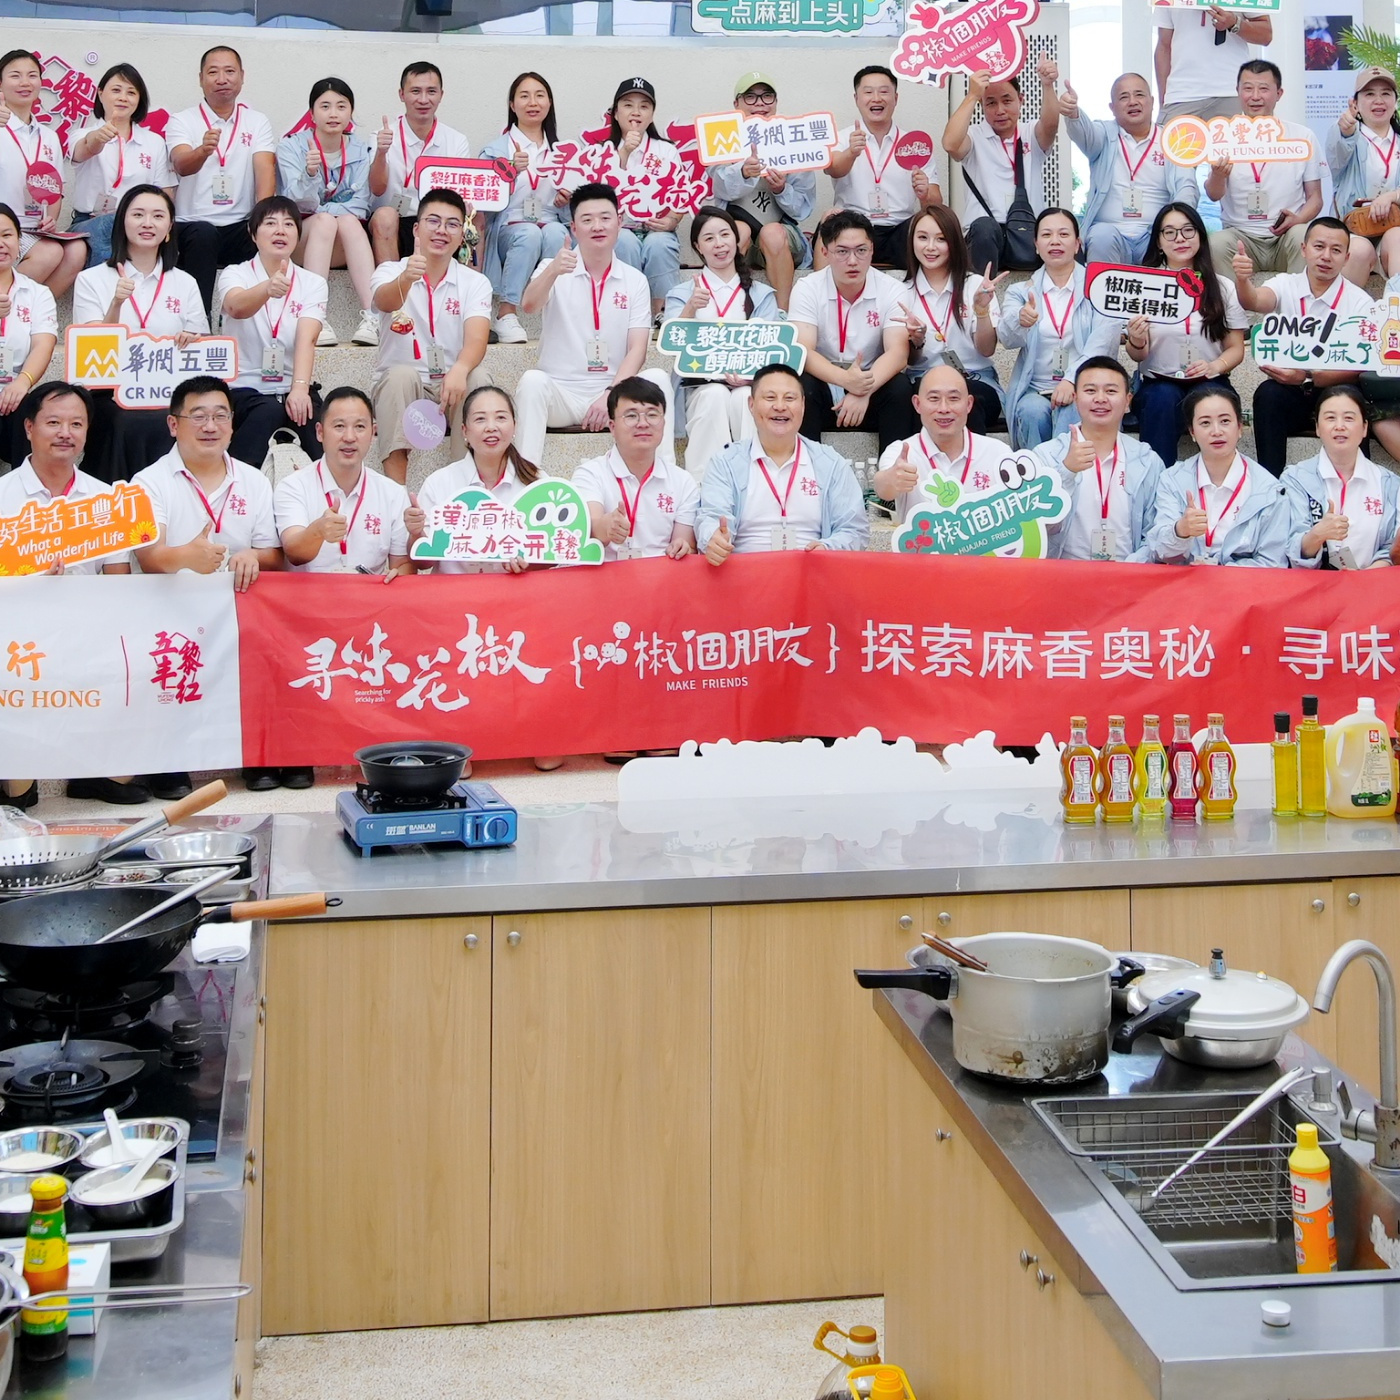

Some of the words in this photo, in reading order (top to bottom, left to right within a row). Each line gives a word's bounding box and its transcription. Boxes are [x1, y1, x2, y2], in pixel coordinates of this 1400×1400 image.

[951, 50, 968, 63] MAKE
[967, 36, 992, 52] FRIENDS
[1212, 123, 1275, 144] 五豐行
[768, 155, 787, 166] NG
[790, 151, 824, 165] FUNG
[1212, 147, 1230, 156] NG
[1233, 146, 1265, 156] FUNG
[1269, 145, 1303, 155] HONG
[430, 171, 500, 187] 黎红麻香浓
[1106, 276, 1179, 299] 椒麻一口
[1104, 295, 1179, 318] 巴适得板
[697, 325, 781, 347] 黎红花椒
[121, 342, 228, 382] 華潤五豐
[125, 386, 145, 400] CR
[150, 385, 172, 399] NG
[68, 488, 142, 530] 五豐行
[933, 483, 1053, 550] 椒個朋友
[17, 539, 51, 556] What
[54, 536, 62, 547] a
[34, 537, 100, 566] Wonderful
[103, 530, 125, 547] Life
[448, 534, 545, 560] 麻力全开
[959, 540, 988, 555] HUAJIAO
[991, 527, 1017, 542] FRIEND
[149, 631, 204, 705] 五丰黎红
[288, 613, 552, 712] 寻味花椒
[634, 622, 814, 681] 椒個朋友
[861, 621, 1213, 681] 探索麻香奥秘
[354, 688, 382, 698] Searching
[383, 687, 392, 696] for
[666, 680, 696, 691] MAKE
[702, 677, 748, 690] FRIENDS
[31, 689, 101, 709] HONG
[354, 696, 374, 705] prickly
[375, 696, 385, 704] ash
